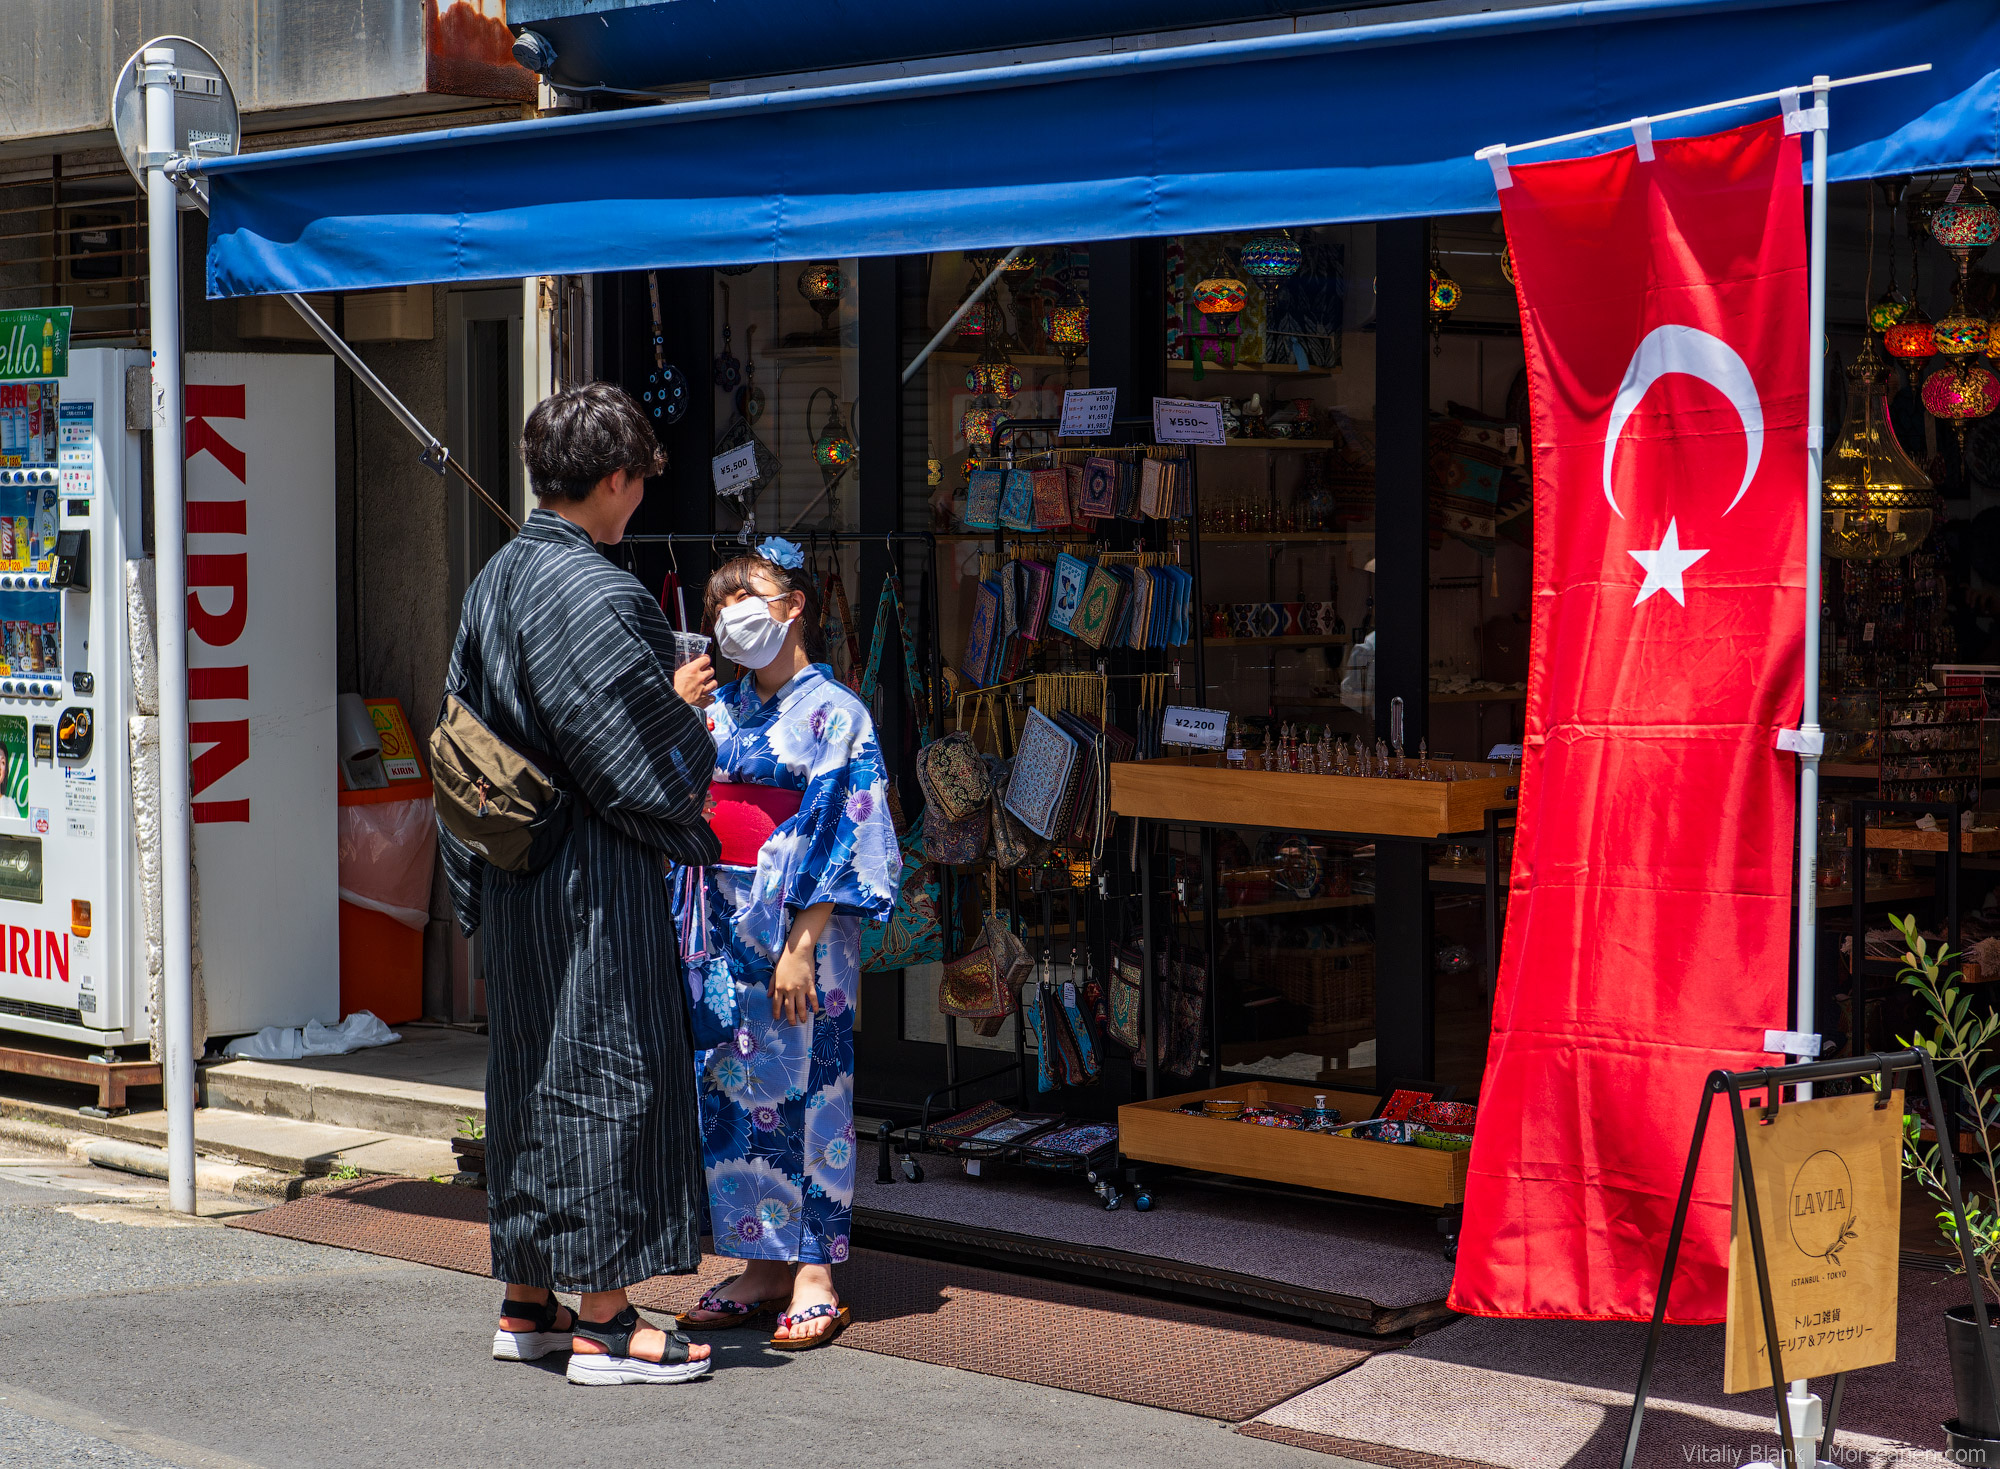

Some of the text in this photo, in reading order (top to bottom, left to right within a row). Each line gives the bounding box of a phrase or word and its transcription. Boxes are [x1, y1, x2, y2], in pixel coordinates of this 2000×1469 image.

[720, 458, 748, 475] ¥5,500
[185, 384, 250, 824] KIRIN
[1175, 719, 1215, 730] ¥2,200
[391, 767, 415, 776] KIRIN
[1795, 1189, 1846, 1217] LAVIA
[1791, 1275, 1820, 1287] ISTANBUL
[1827, 1270, 1847, 1280] TOKYO
[1795, 1308, 1841, 1329] トルコ雑貨
[1758, 1324, 1873, 1357] イテリア&アクセサリー
